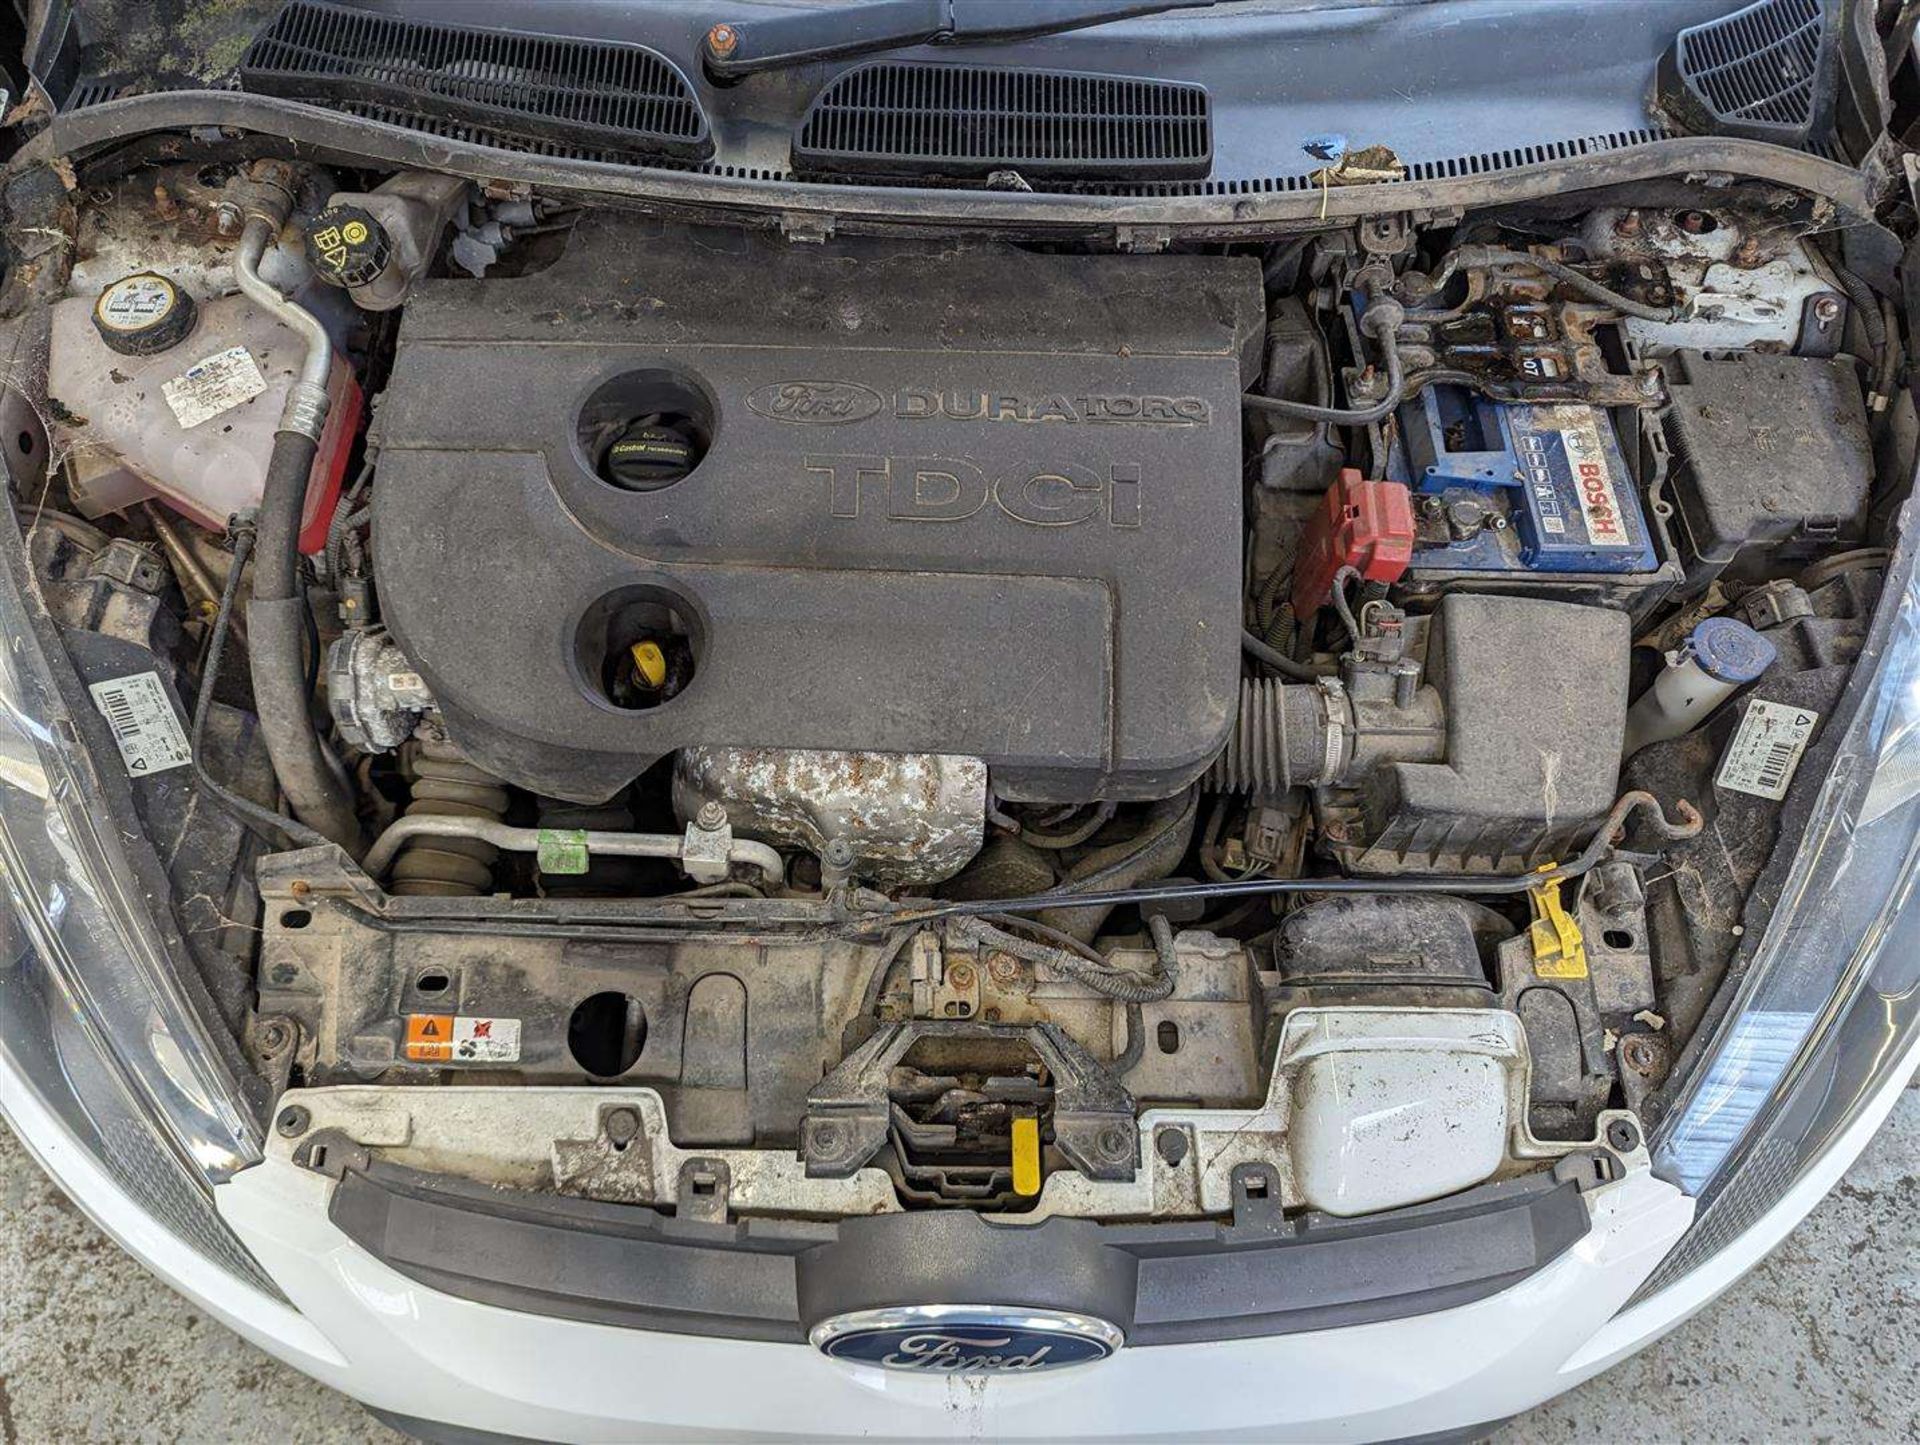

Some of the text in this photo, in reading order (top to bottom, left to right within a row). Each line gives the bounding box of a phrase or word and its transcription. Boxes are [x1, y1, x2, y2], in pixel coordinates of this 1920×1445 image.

[770, 383, 1212, 425] Ford DURATORQ
[1578, 463, 1617, 534] BOSCH
[882, 1333, 1053, 1371] Ford
